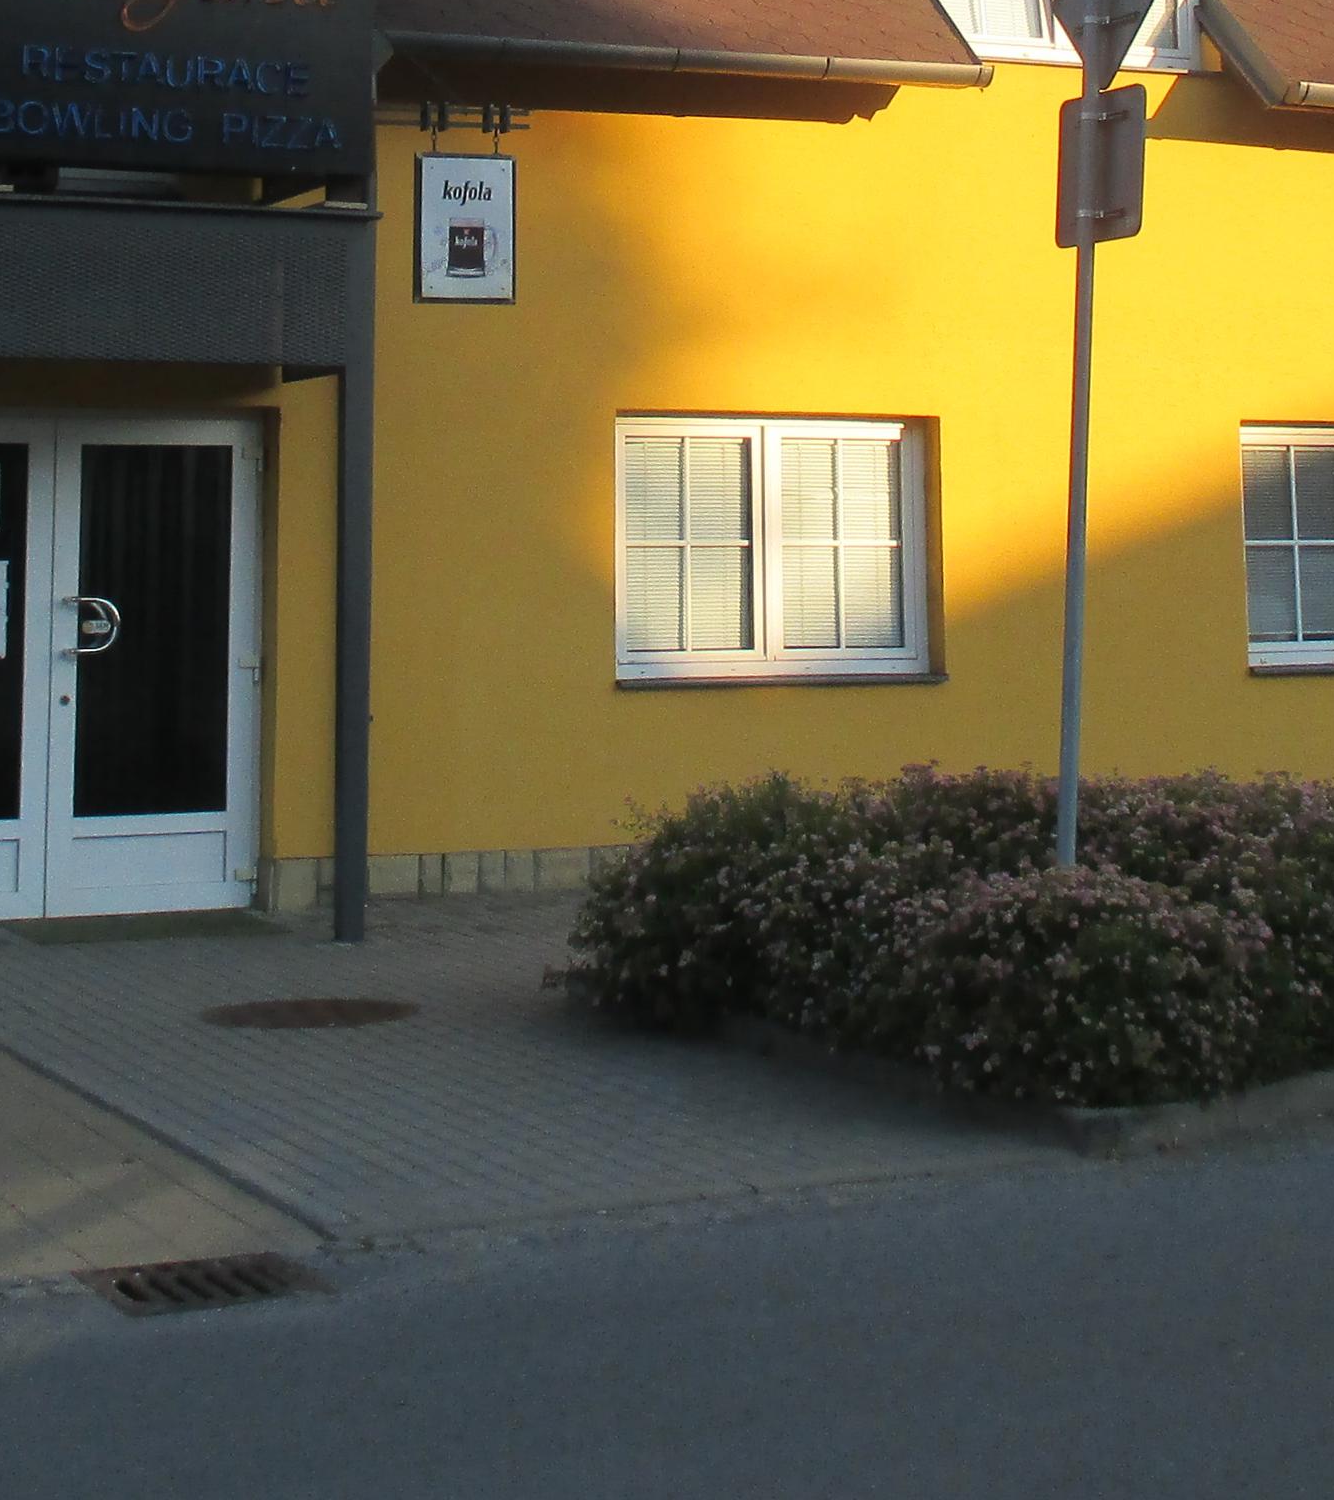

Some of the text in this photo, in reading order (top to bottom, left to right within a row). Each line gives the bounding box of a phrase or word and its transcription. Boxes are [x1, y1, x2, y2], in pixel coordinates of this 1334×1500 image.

[21, 44, 311, 96] RESTAURACE
[222, 112, 342, 149] PIZZA
[442, 179, 492, 206] kofola
